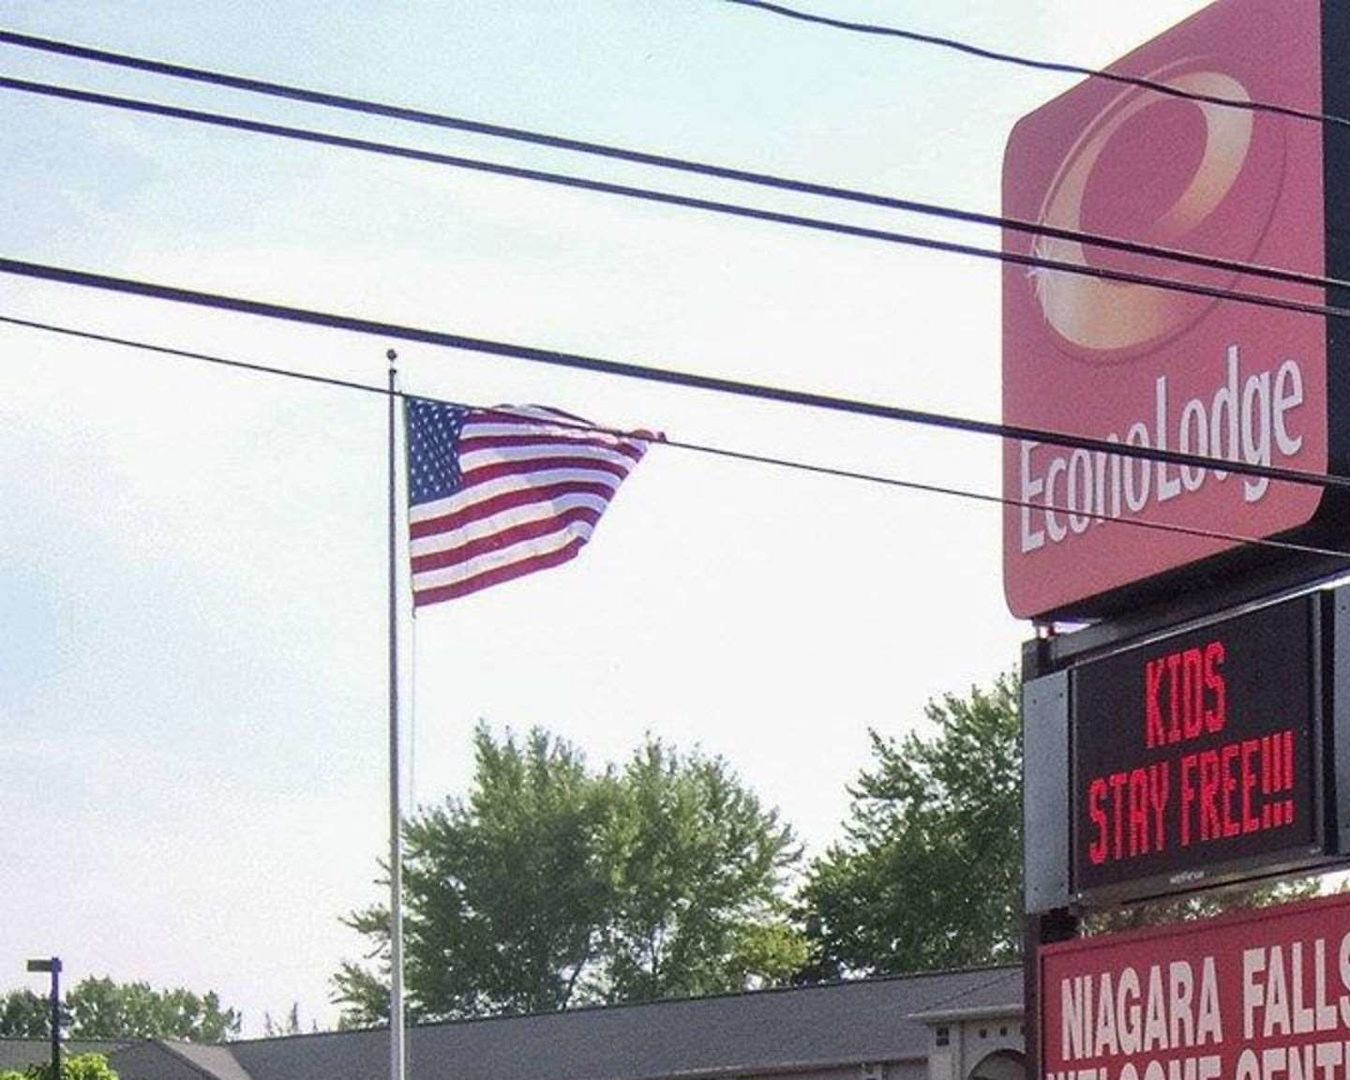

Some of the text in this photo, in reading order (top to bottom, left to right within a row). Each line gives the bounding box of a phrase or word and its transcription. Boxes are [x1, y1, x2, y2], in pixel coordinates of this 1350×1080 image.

[1145, 641, 1226, 748] KIDS
[1089, 731, 1295, 865] STAY FREE!!!
[1061, 956, 1223, 1061] NIAGARA
